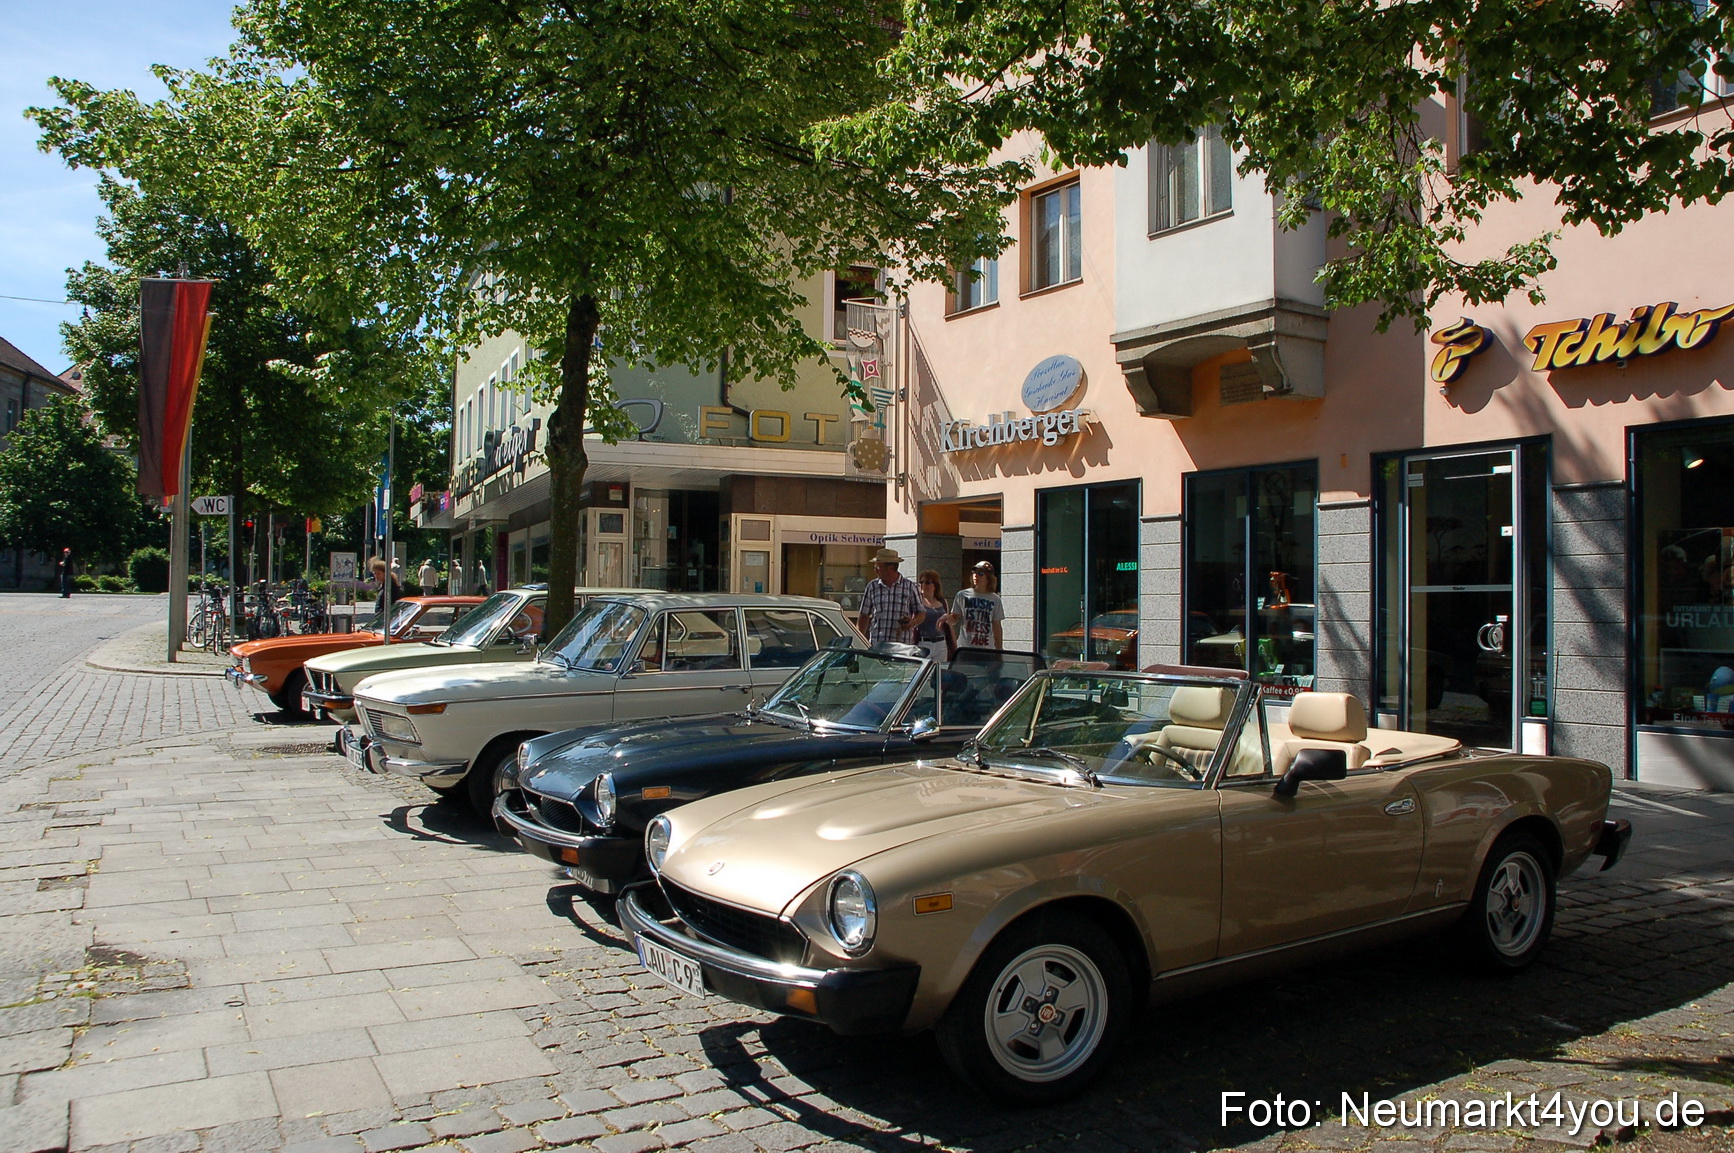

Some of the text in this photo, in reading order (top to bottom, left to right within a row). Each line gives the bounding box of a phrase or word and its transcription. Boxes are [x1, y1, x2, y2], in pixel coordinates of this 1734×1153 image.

[1522, 302, 1734, 371] Tchibo
[939, 408, 1086, 453] Kirchberger
[203, 498, 226, 513] WC
[810, 533, 838, 544] Optik
[1116, 562, 1138, 571] ALESSI
[965, 597, 995, 611] MUSIC
[966, 621, 991, 634] MESS
[971, 634, 990, 646] AGE
[1262, 685, 1283, 695] Kaffee
[1673, 712, 1698, 723] Eine
[641, 942, 667, 977] LAU
